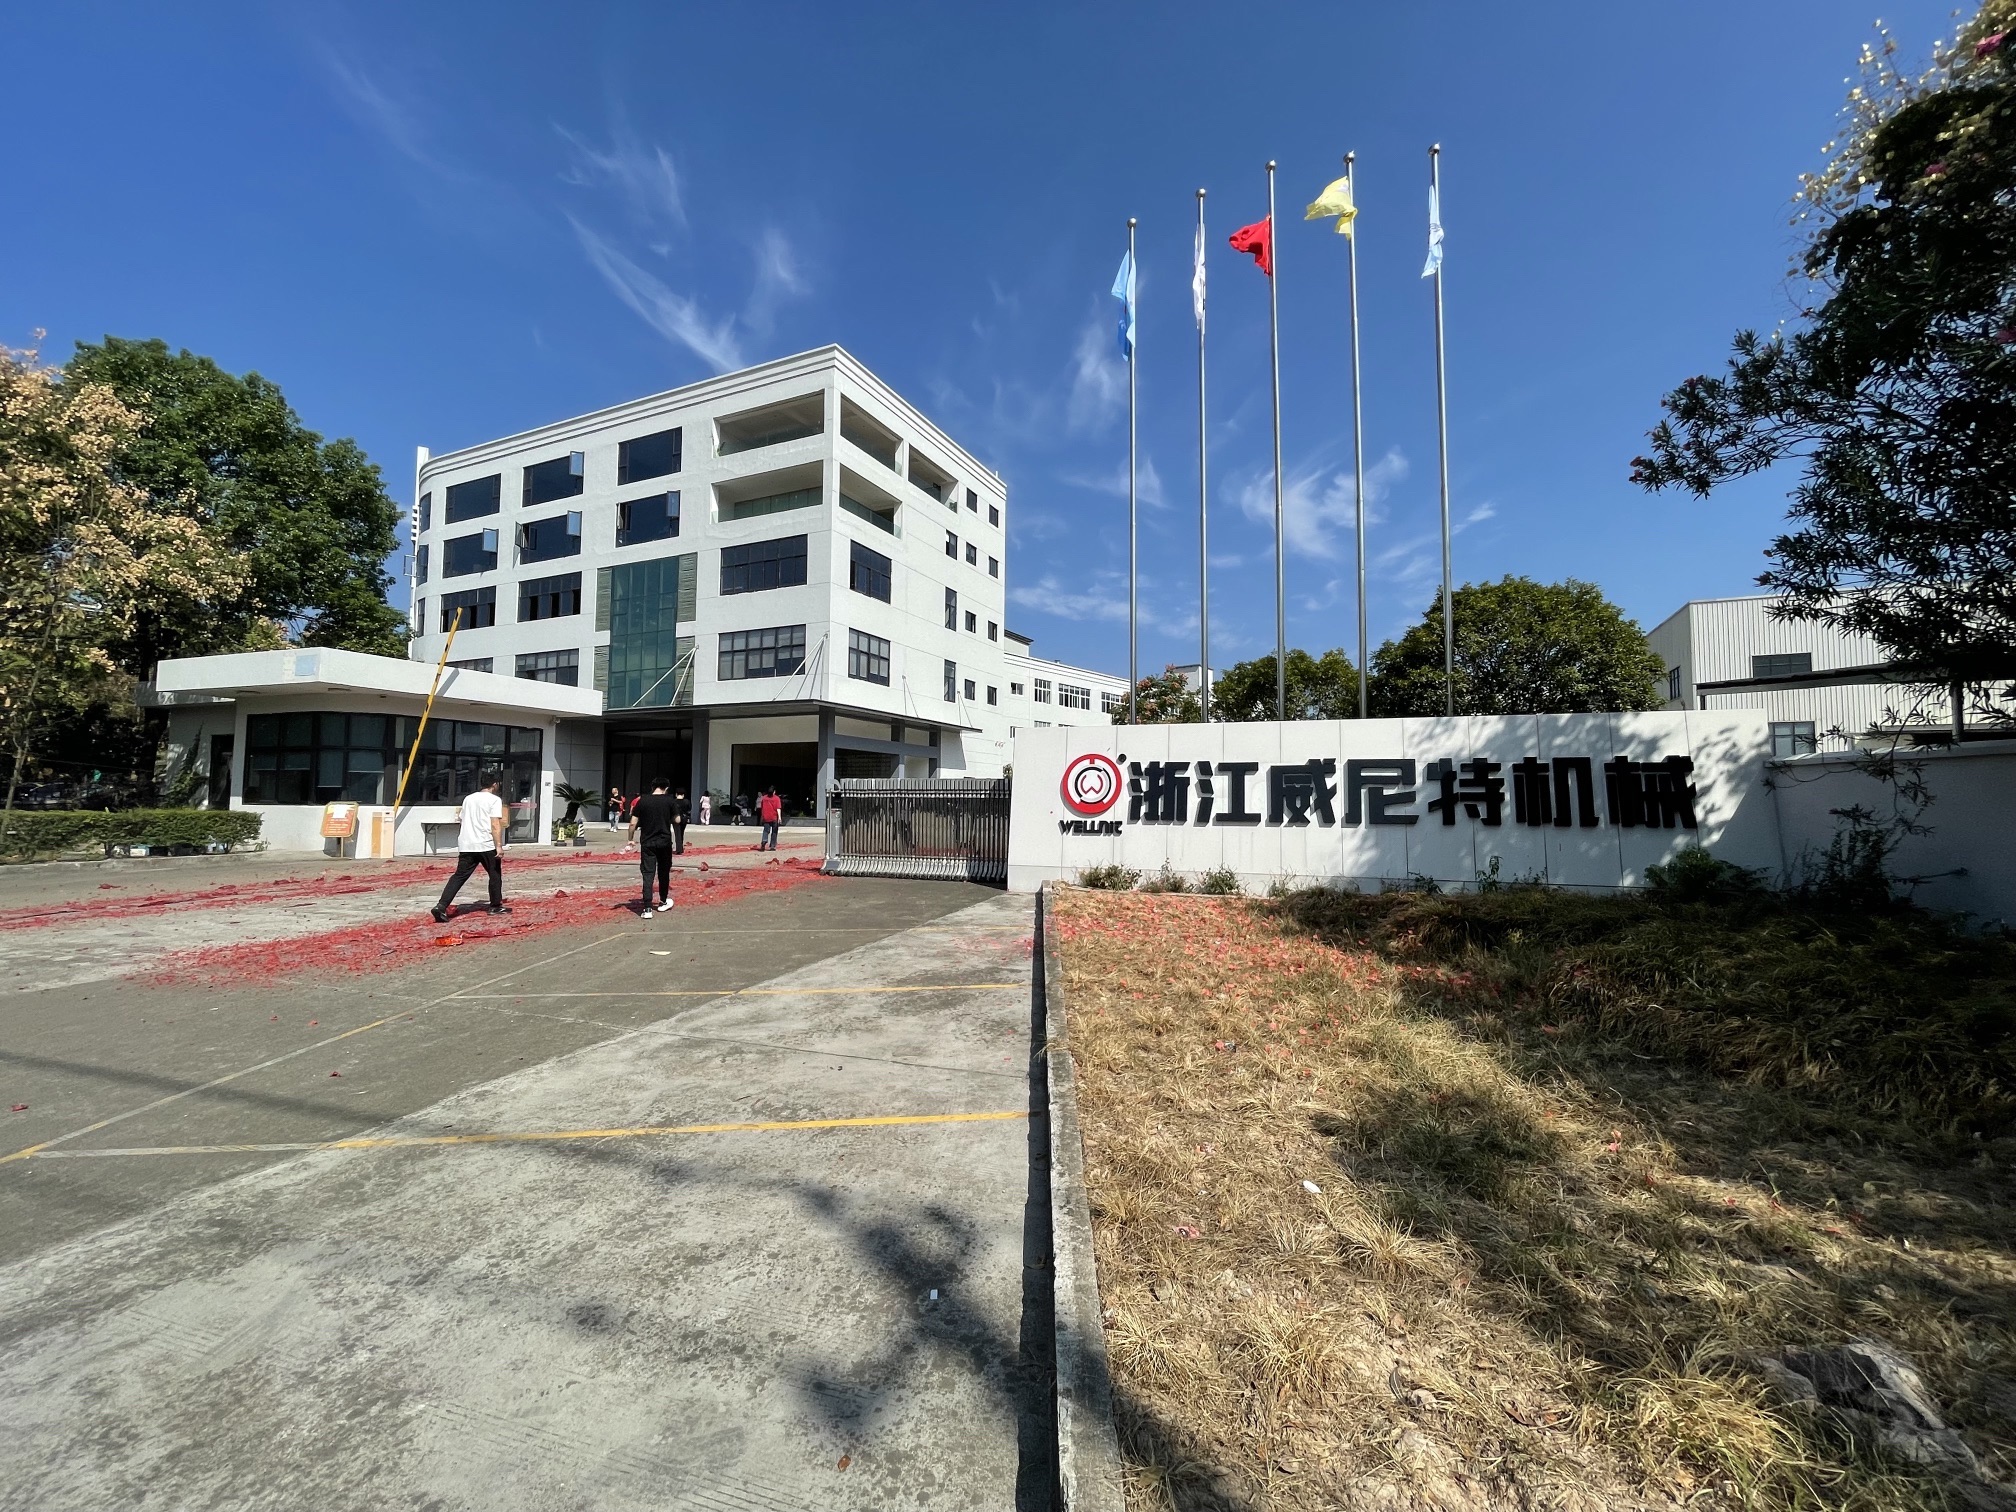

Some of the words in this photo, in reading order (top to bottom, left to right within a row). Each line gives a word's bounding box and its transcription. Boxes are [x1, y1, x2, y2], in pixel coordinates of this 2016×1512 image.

[1127, 756, 1698, 828] 浙江威尼特机械
